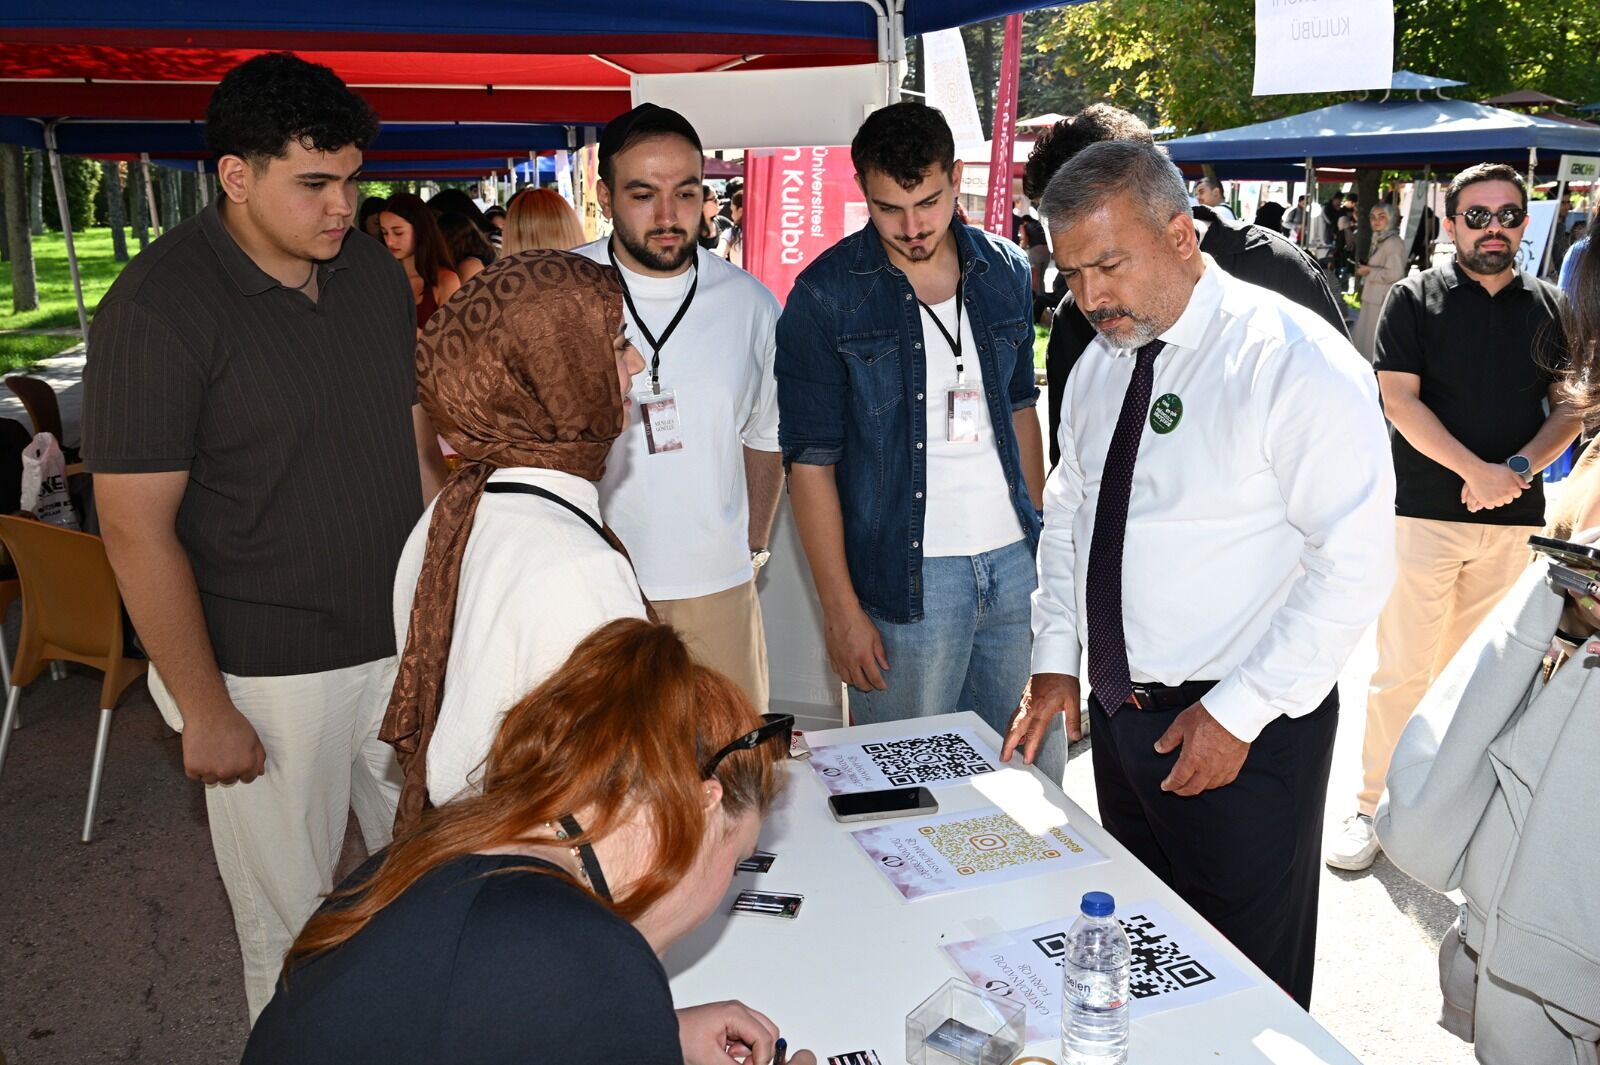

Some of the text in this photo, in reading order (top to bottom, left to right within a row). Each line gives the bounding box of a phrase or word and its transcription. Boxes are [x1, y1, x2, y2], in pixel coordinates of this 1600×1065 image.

[781, 169, 805, 265] Kulübü
[811, 147, 828, 238] Üniversitesi
[992, 954, 1050, 1016] GASTROANADOLU
[1030, 973, 1053, 997] FORM
